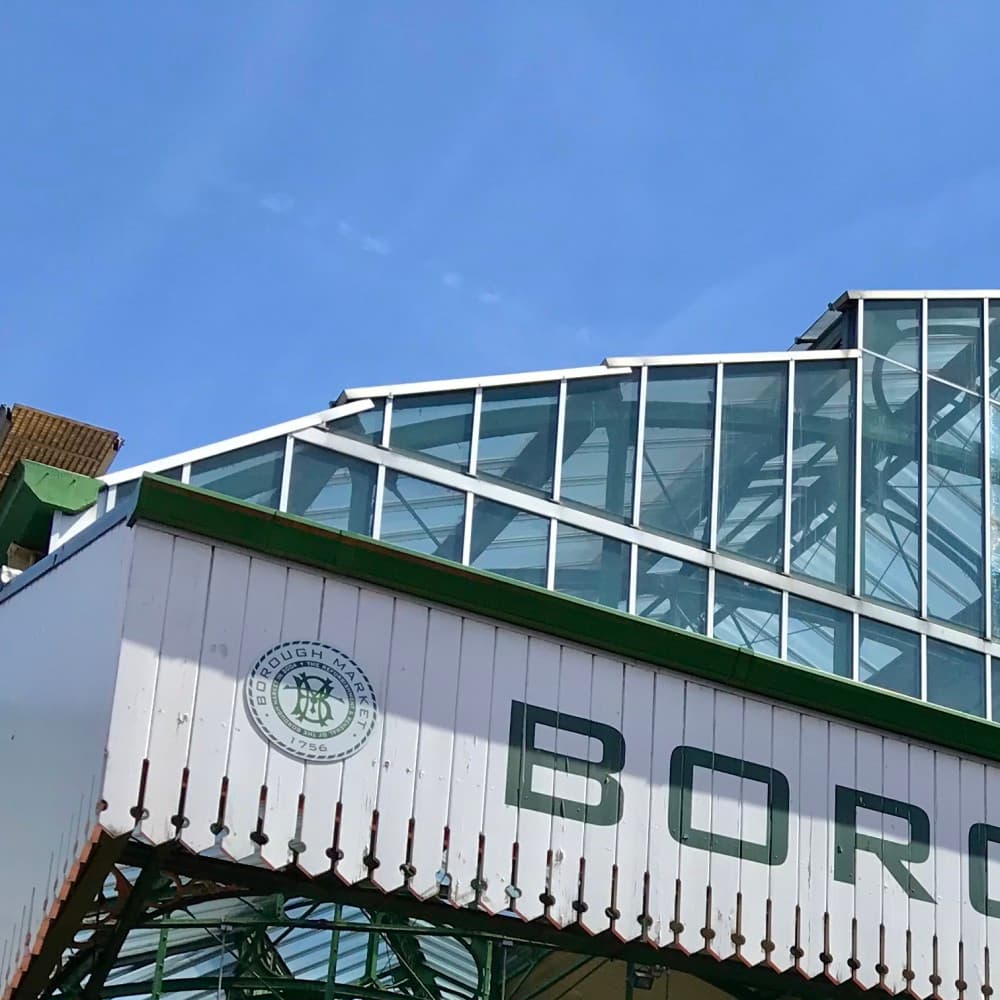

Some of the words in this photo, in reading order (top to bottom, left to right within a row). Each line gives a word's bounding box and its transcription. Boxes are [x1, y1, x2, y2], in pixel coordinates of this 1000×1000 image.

[256, 648, 323, 706] BOROUGH
[332, 657, 370, 729] MARKET
[288, 735, 329, 752] 1756
